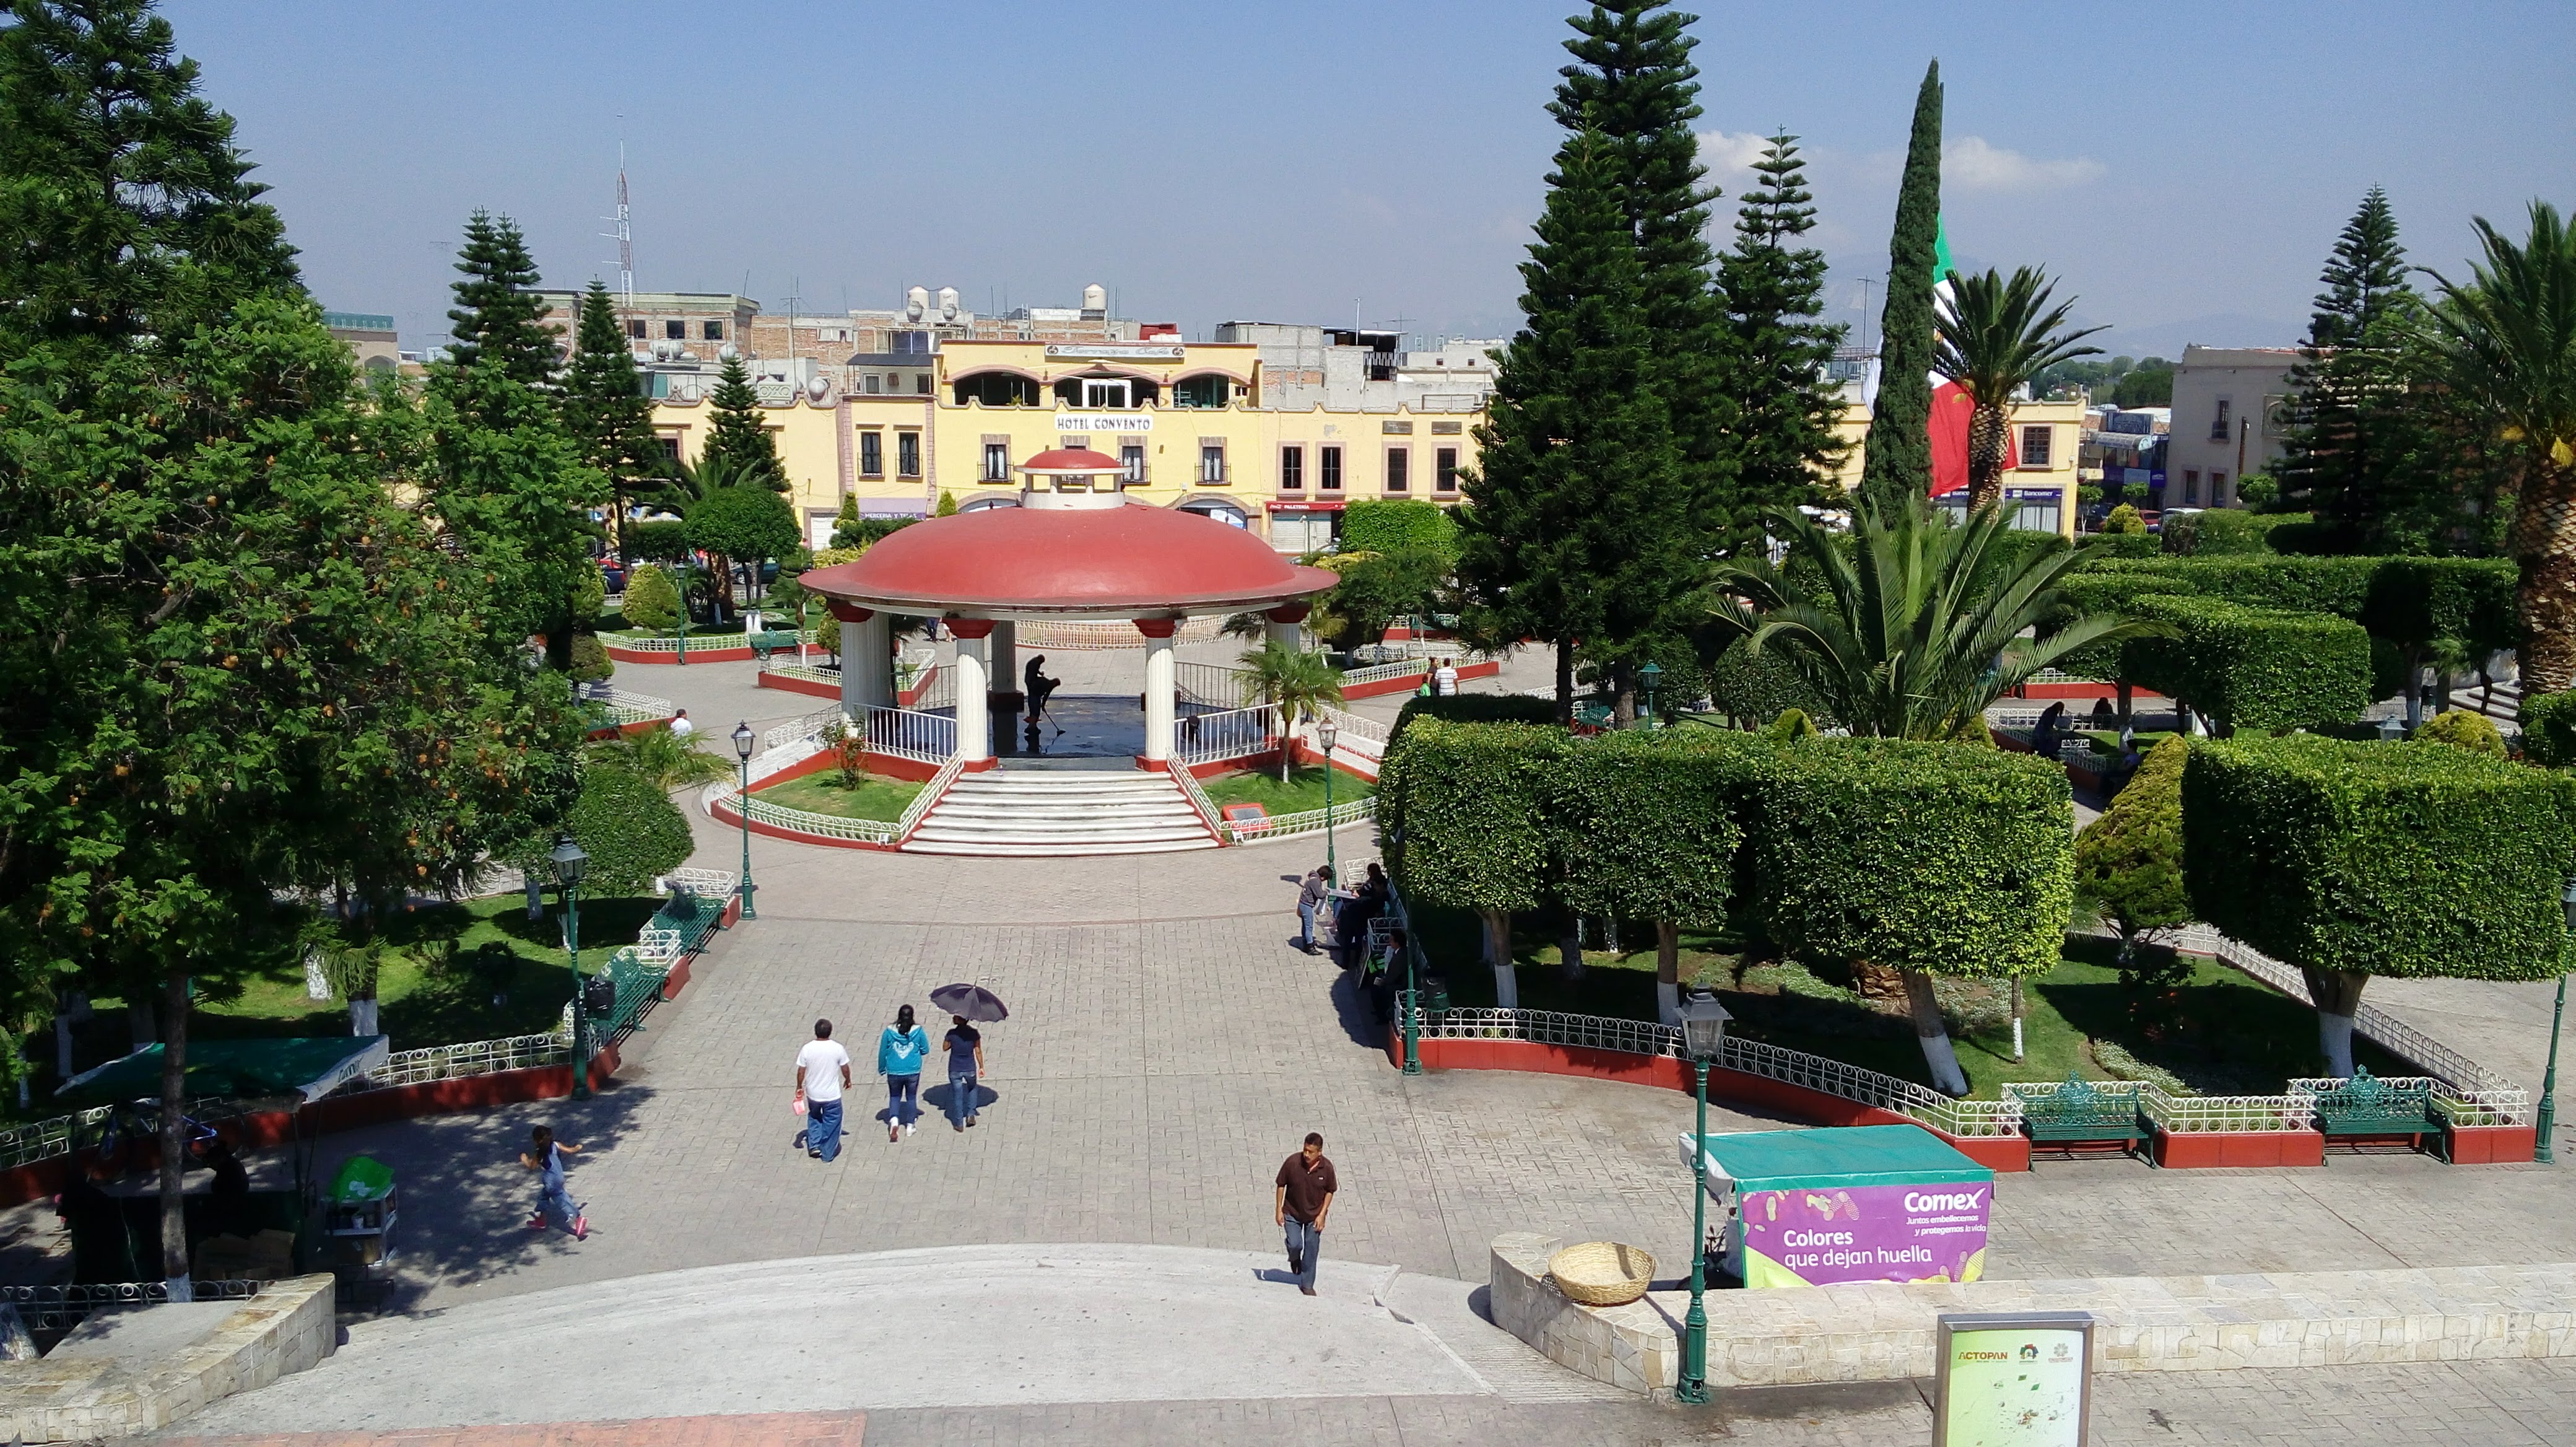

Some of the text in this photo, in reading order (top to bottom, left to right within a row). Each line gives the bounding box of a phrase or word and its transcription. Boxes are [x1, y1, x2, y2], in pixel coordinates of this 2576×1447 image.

[1058, 418, 1150, 430] HOTEL CONVENTO
[1904, 1187, 1986, 1212] Comex
[1906, 1215, 1979, 1225] Juntos embellecemos
[1914, 1228, 1920, 1236] y
[1921, 1226, 1964, 1236] protegemos
[1783, 1228, 1854, 1247] Colores
[1785, 1244, 1933, 1270] que dejan huella
[1958, 1352, 2008, 1360] ACTOPAN
